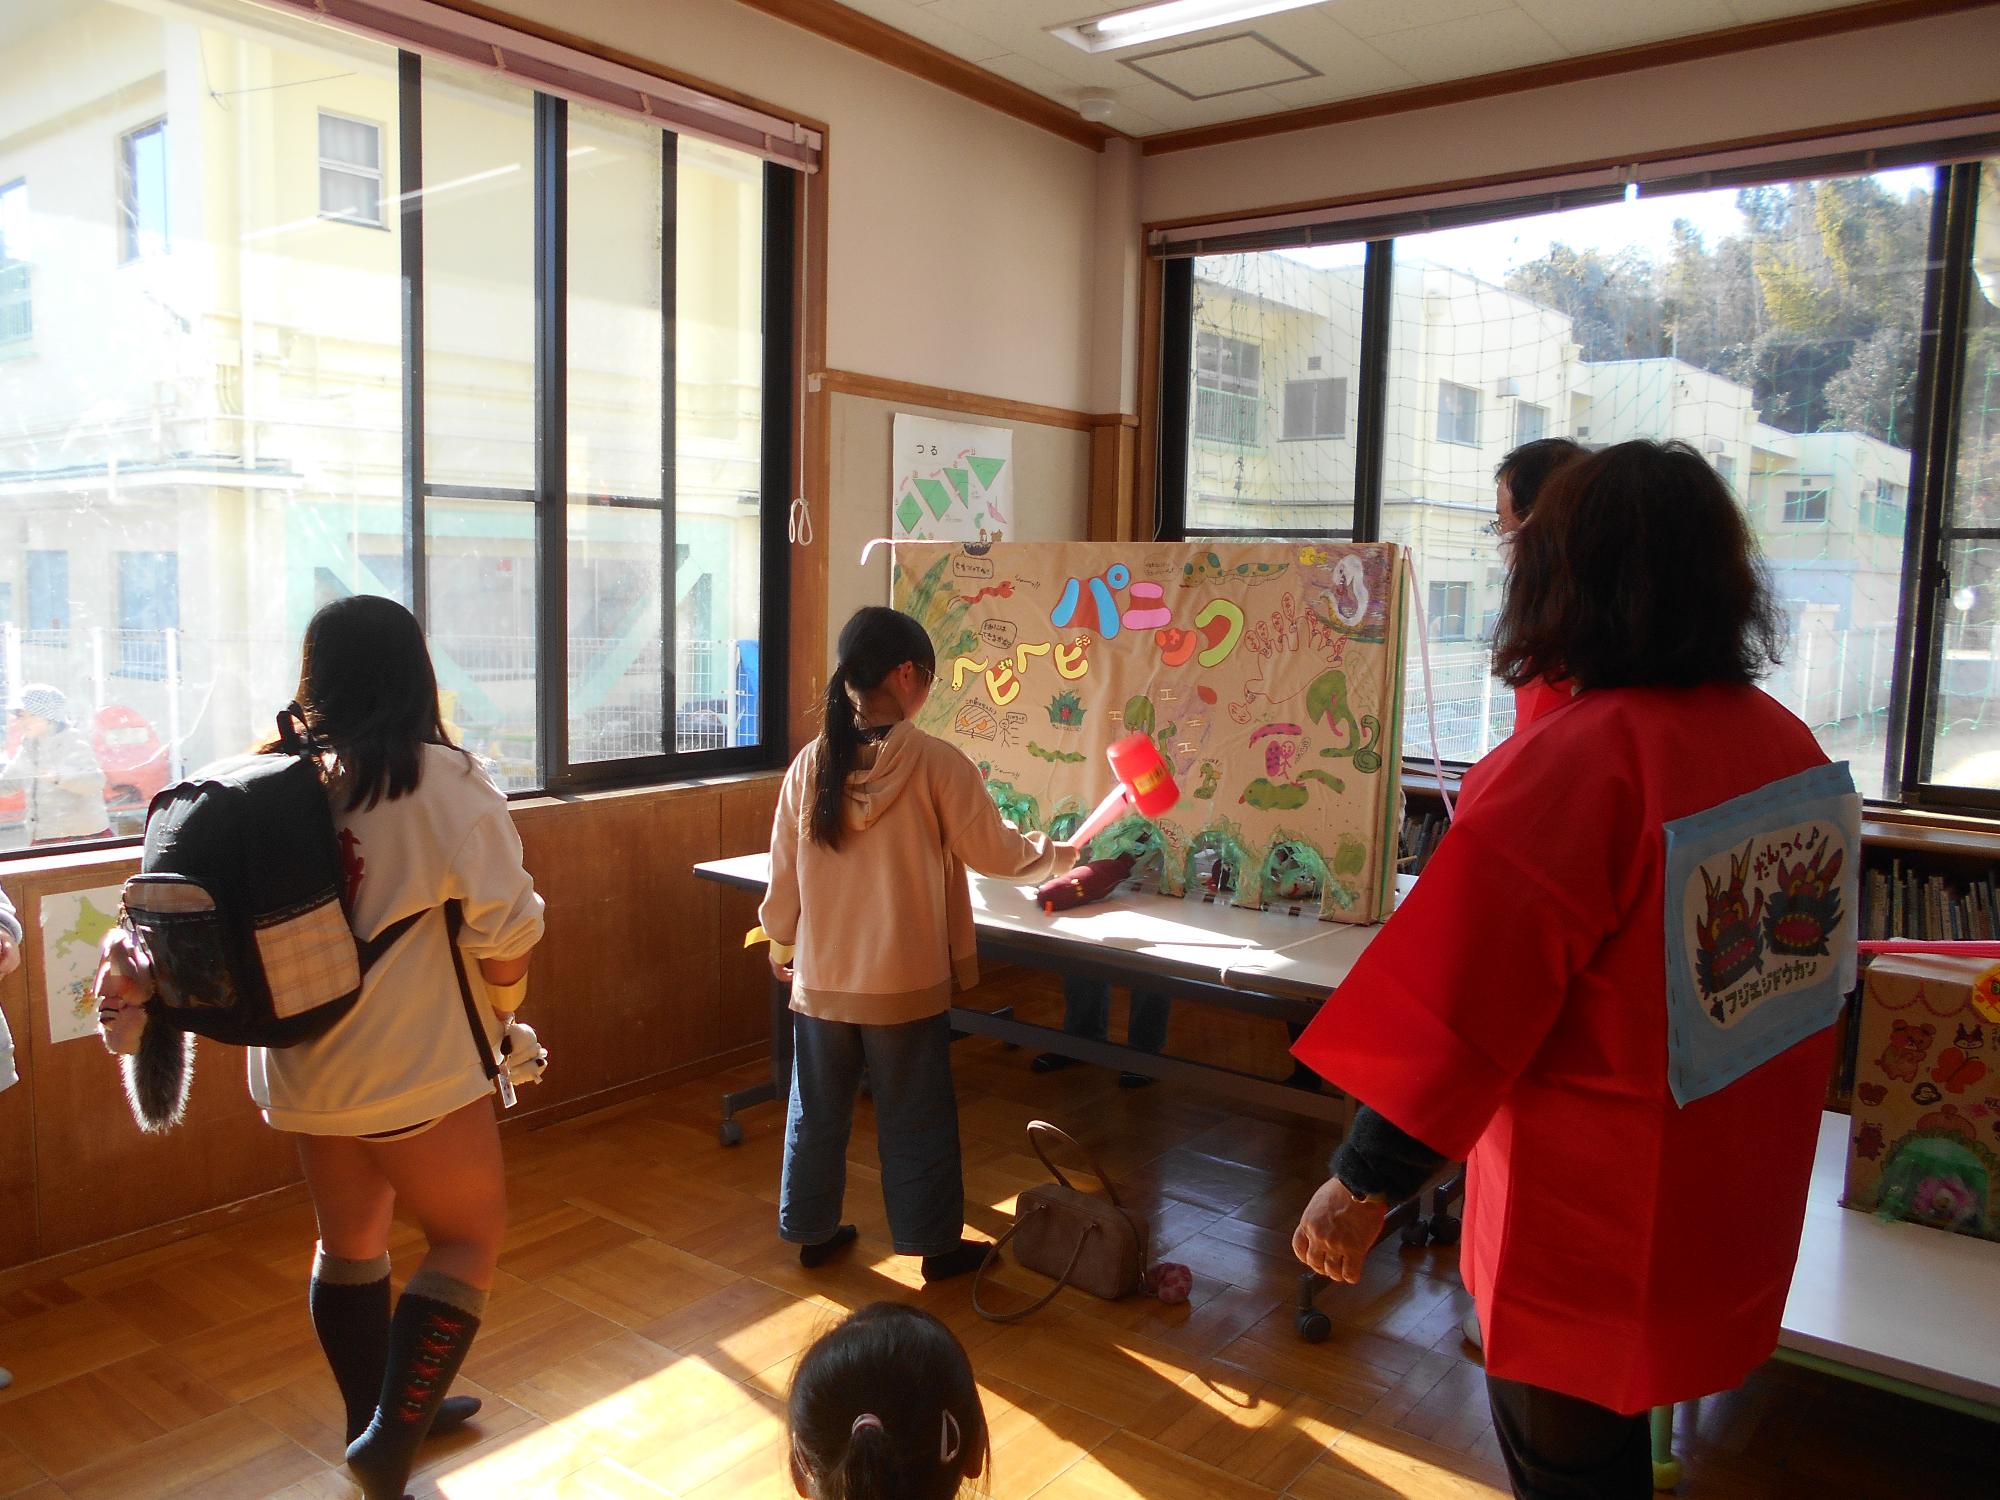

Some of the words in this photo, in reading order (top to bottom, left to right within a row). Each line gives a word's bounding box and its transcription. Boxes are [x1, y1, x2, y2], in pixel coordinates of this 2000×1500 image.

[916, 444, 938, 456] つる
[1050, 562, 1245, 668] パニック
[951, 634, 1092, 707] ヘビヘビ
[1753, 832, 1804, 881] だんつく
[1725, 961, 1818, 1014] フジエジドウカン
